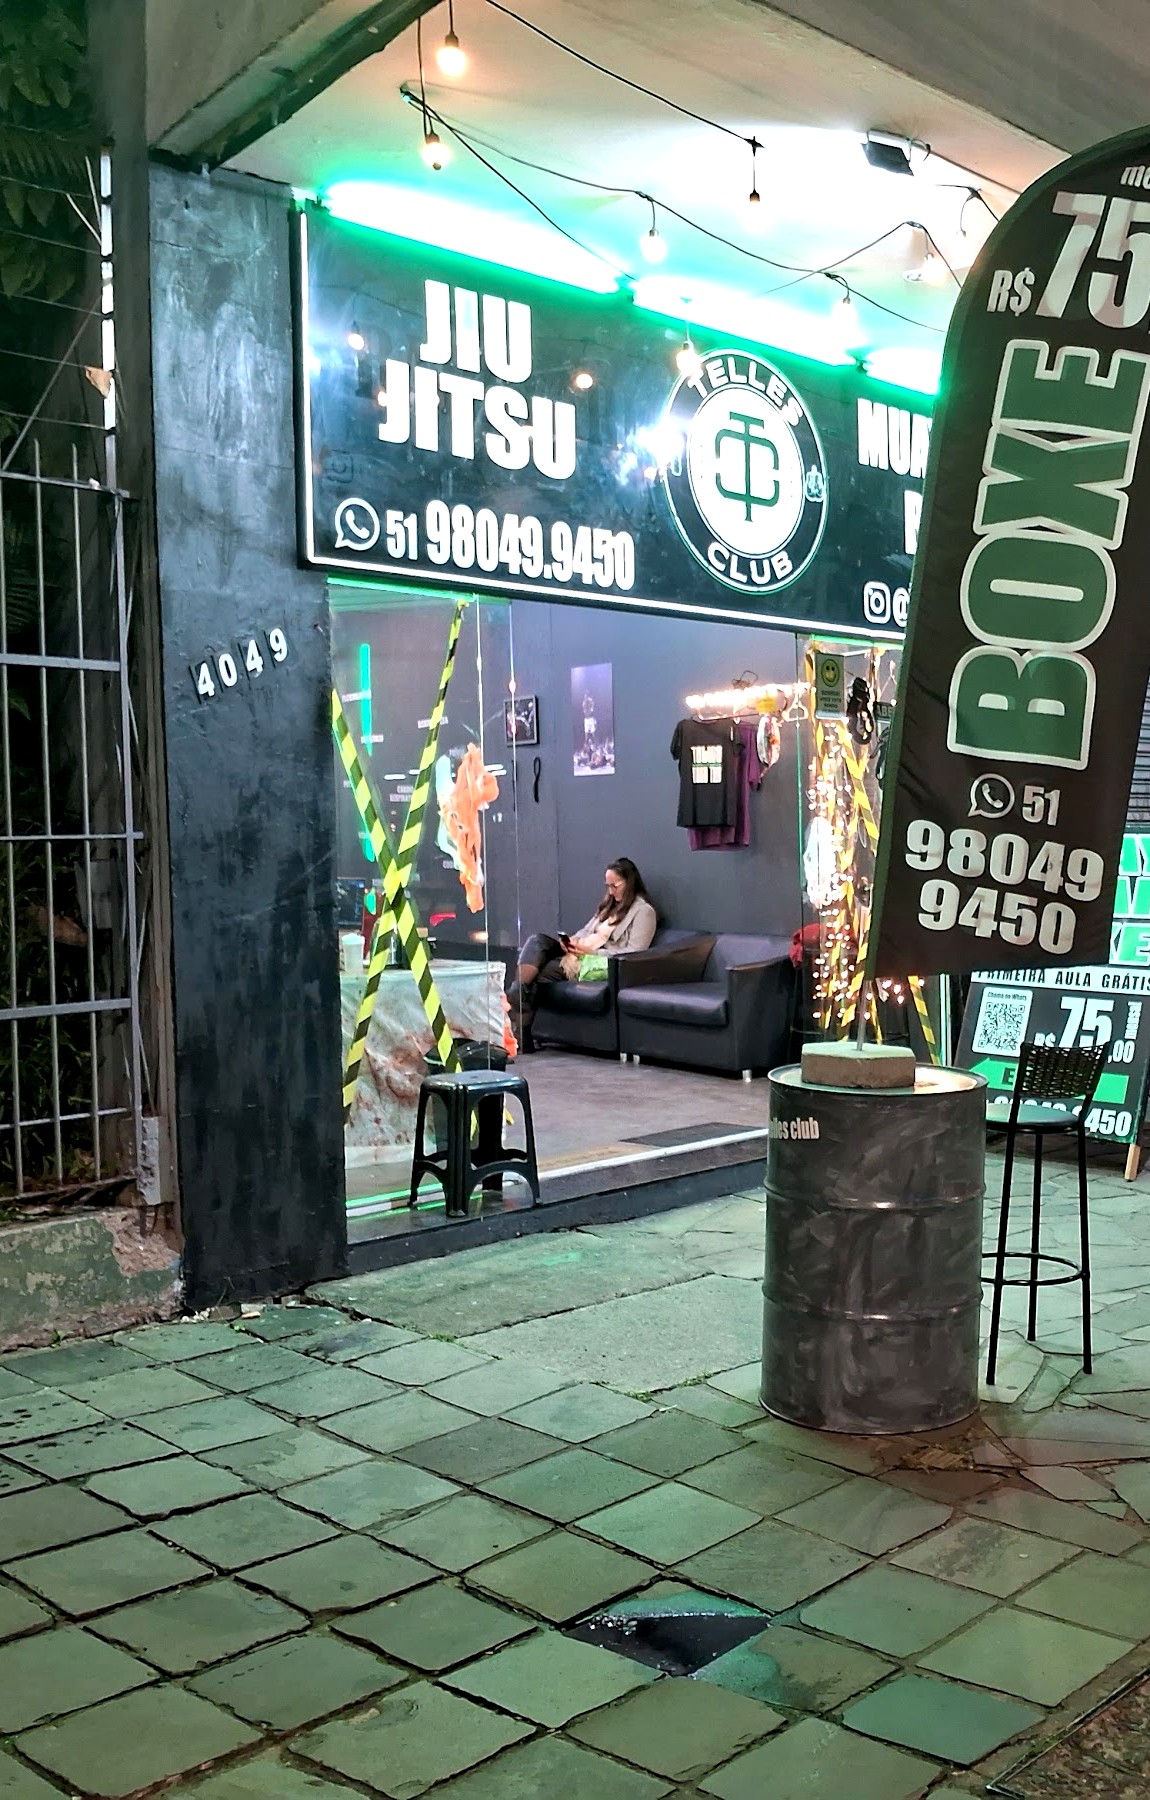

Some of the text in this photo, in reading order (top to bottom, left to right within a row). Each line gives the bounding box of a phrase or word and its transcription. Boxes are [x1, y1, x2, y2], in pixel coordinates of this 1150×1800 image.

[987, 267, 1036, 317] R$
[419, 279, 533, 384] JIU
[378, 358, 577, 481] JITSU
[687, 356, 804, 427] TELLES
[386, 499, 636, 591] 51 98049.9450
[706, 541, 794, 585] CLUB
[947, 338, 1150, 771] BOXE
[197, 627, 289, 698] 4049
[1022, 784, 1061, 827] 51
[905, 818, 1105, 902] 98049
[918, 878, 1077, 955] 9450
[1055, 971, 1091, 987] AULA
[1058, 996, 1115, 1050] 75
[790, 1116, 820, 1139] club
